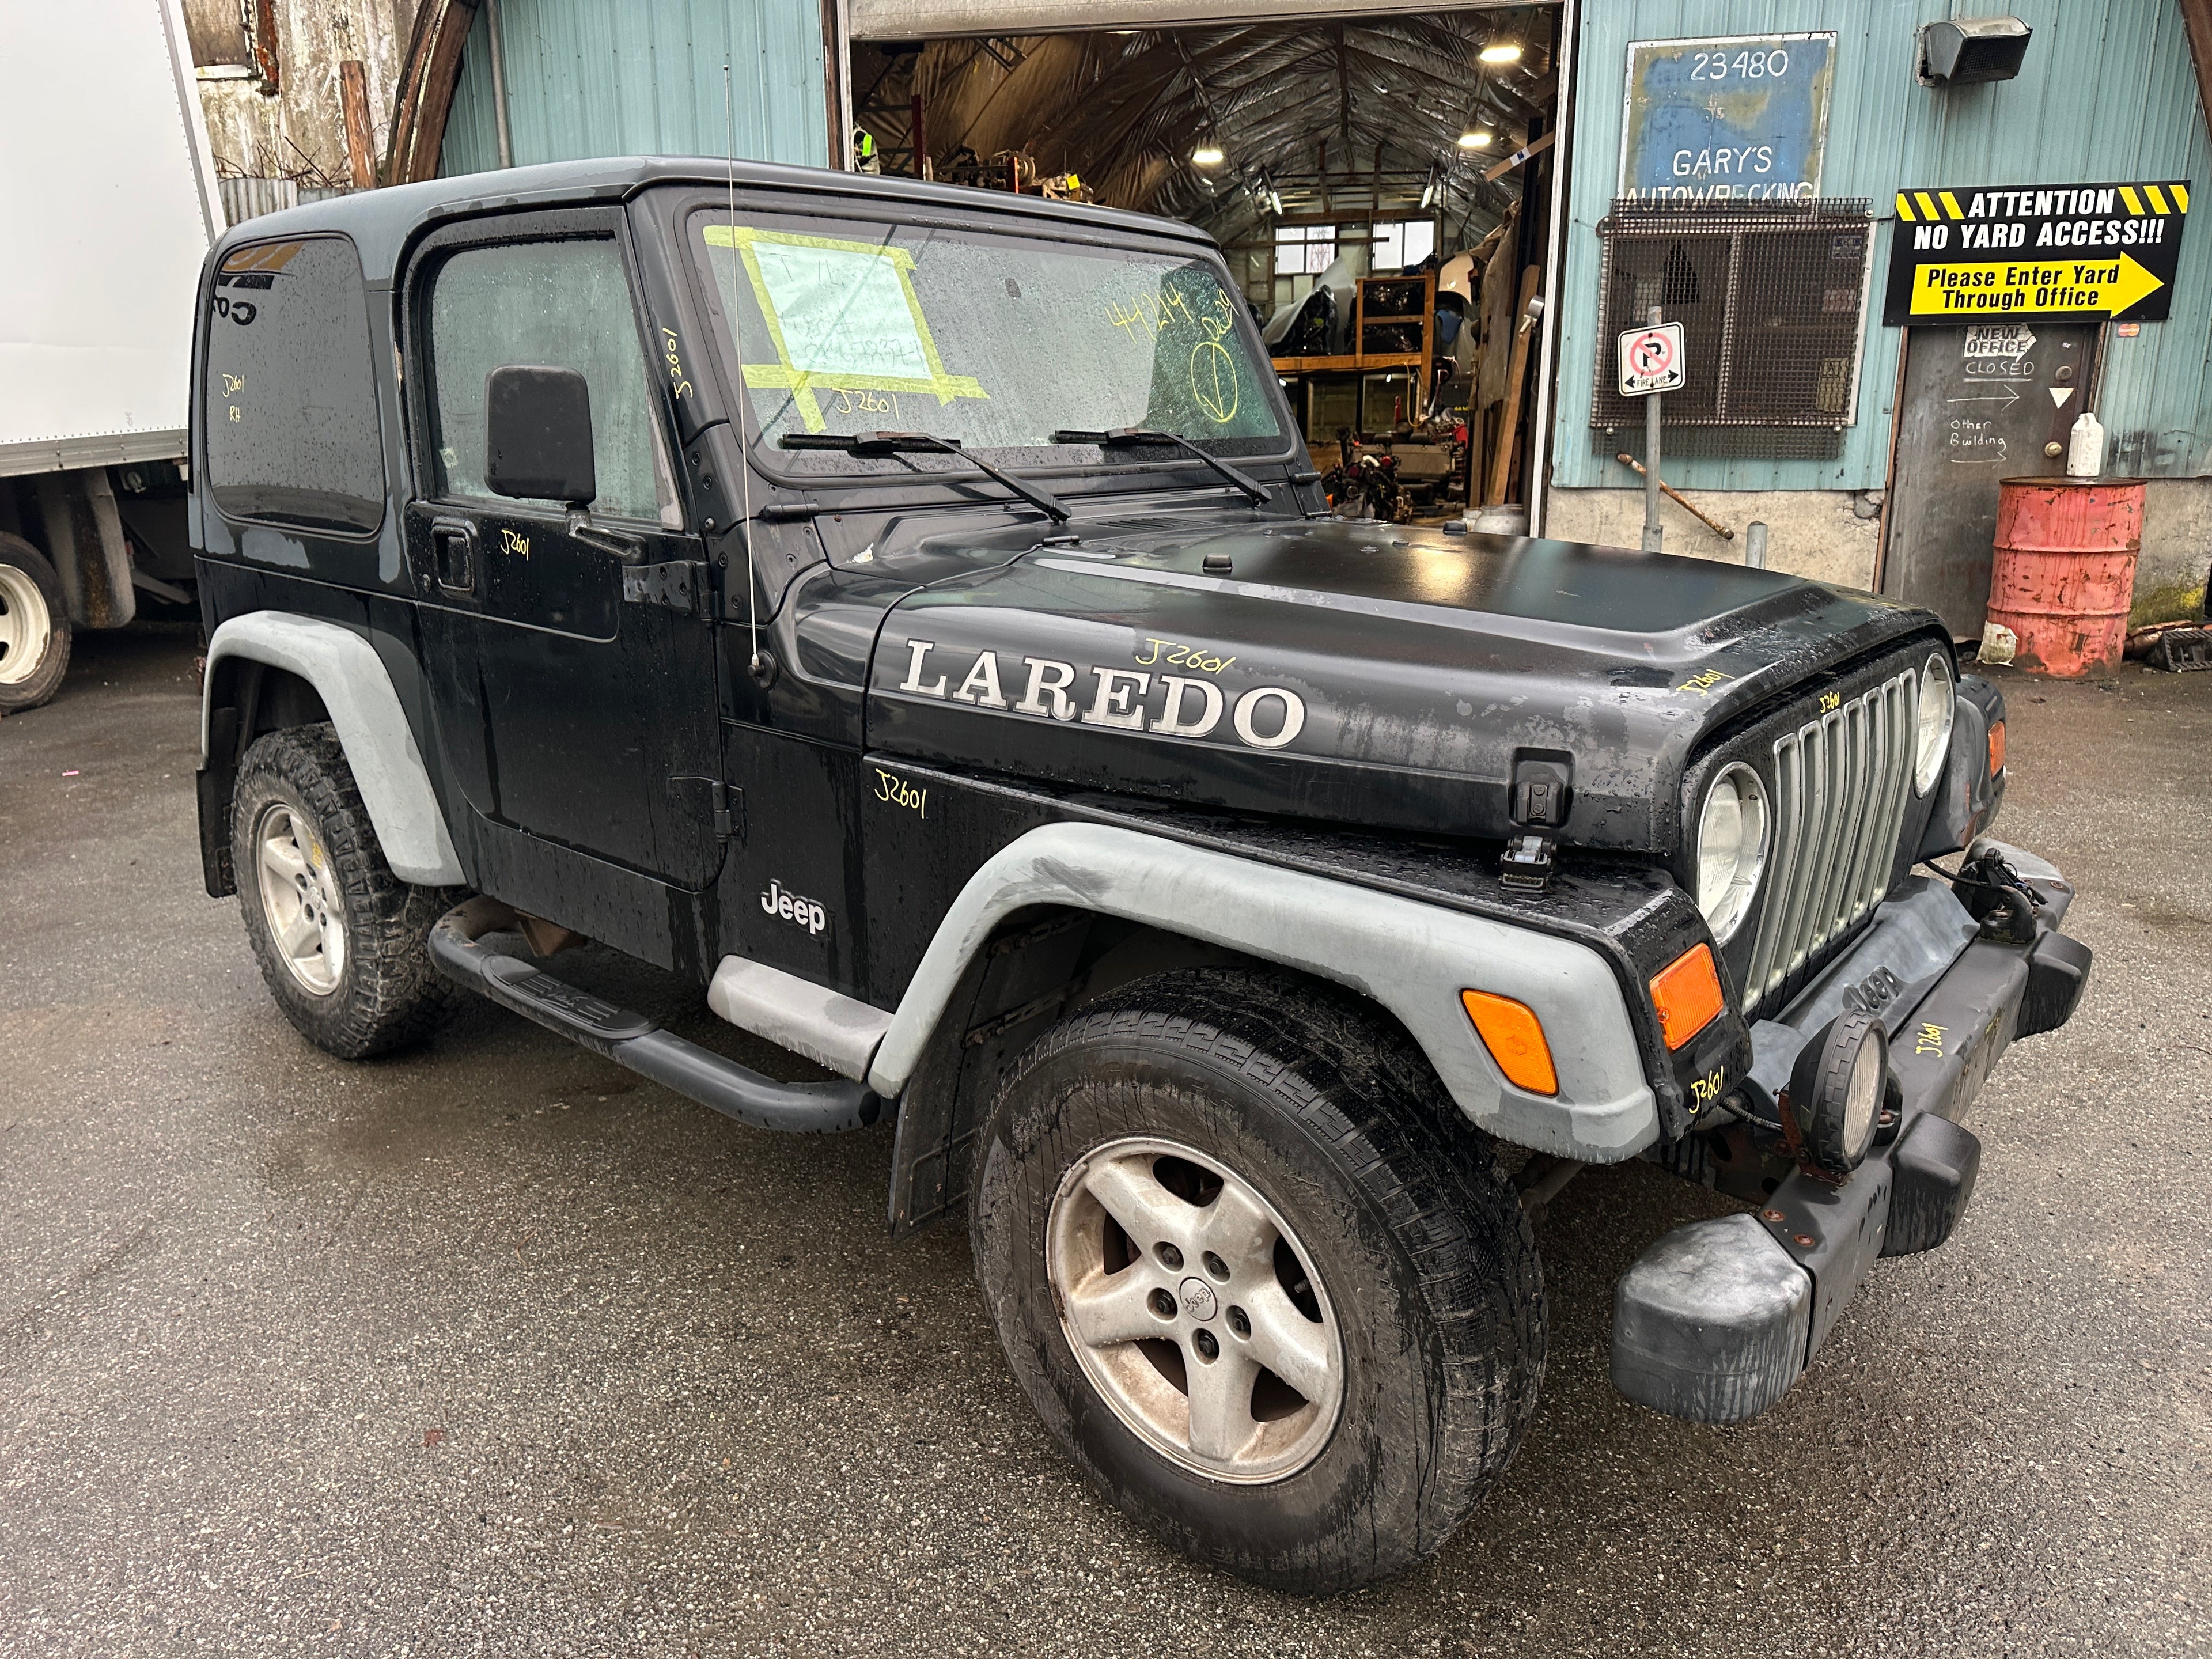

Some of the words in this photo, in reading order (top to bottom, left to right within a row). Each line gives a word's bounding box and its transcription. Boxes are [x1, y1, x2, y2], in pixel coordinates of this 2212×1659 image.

[1690, 50, 1789, 81] 23480
[1673, 146, 1772, 176] GARY'S
[1967, 188, 2115, 218] ATTENTION
[1914, 225, 1950, 250] NO
[1961, 223, 2027, 248] YARD
[2036, 219, 2165, 246] ACCESS!!!
[1927, 268, 1996, 288] Please
[2005, 266, 2063, 286] Enter
[2074, 264, 2120, 284] Yard
[1943, 287, 2026, 311] Through
[2035, 287, 2099, 307] Office
[1966, 339, 2028, 354] OFFICE
[1976, 327, 2020, 340] NEW
[662, 327, 693, 399] J2601
[1965, 361, 2035, 376] CLOSED
[222, 373, 245, 397] J2601
[1637, 378, 1650, 388] FIRE
[229, 405, 241, 423] RH
[831, 387, 900, 419] J2601
[1950, 419, 1992, 431] Other
[1950, 433, 2006, 453] Building
[500, 529, 529, 562] J2601
[1135, 637, 1237, 675] J2601
[899, 637, 1308, 749] LAREDO
[1675, 668, 1736, 697] J2601
[1820, 691, 1840, 713] J2601
[873, 768, 927, 819] J2601
[760, 882, 826, 935] Jeep
[1915, 1022, 1949, 1058] J2601
[1688, 1065, 1724, 1114] J2601
[1185, 1286, 1212, 1313] Jeep
